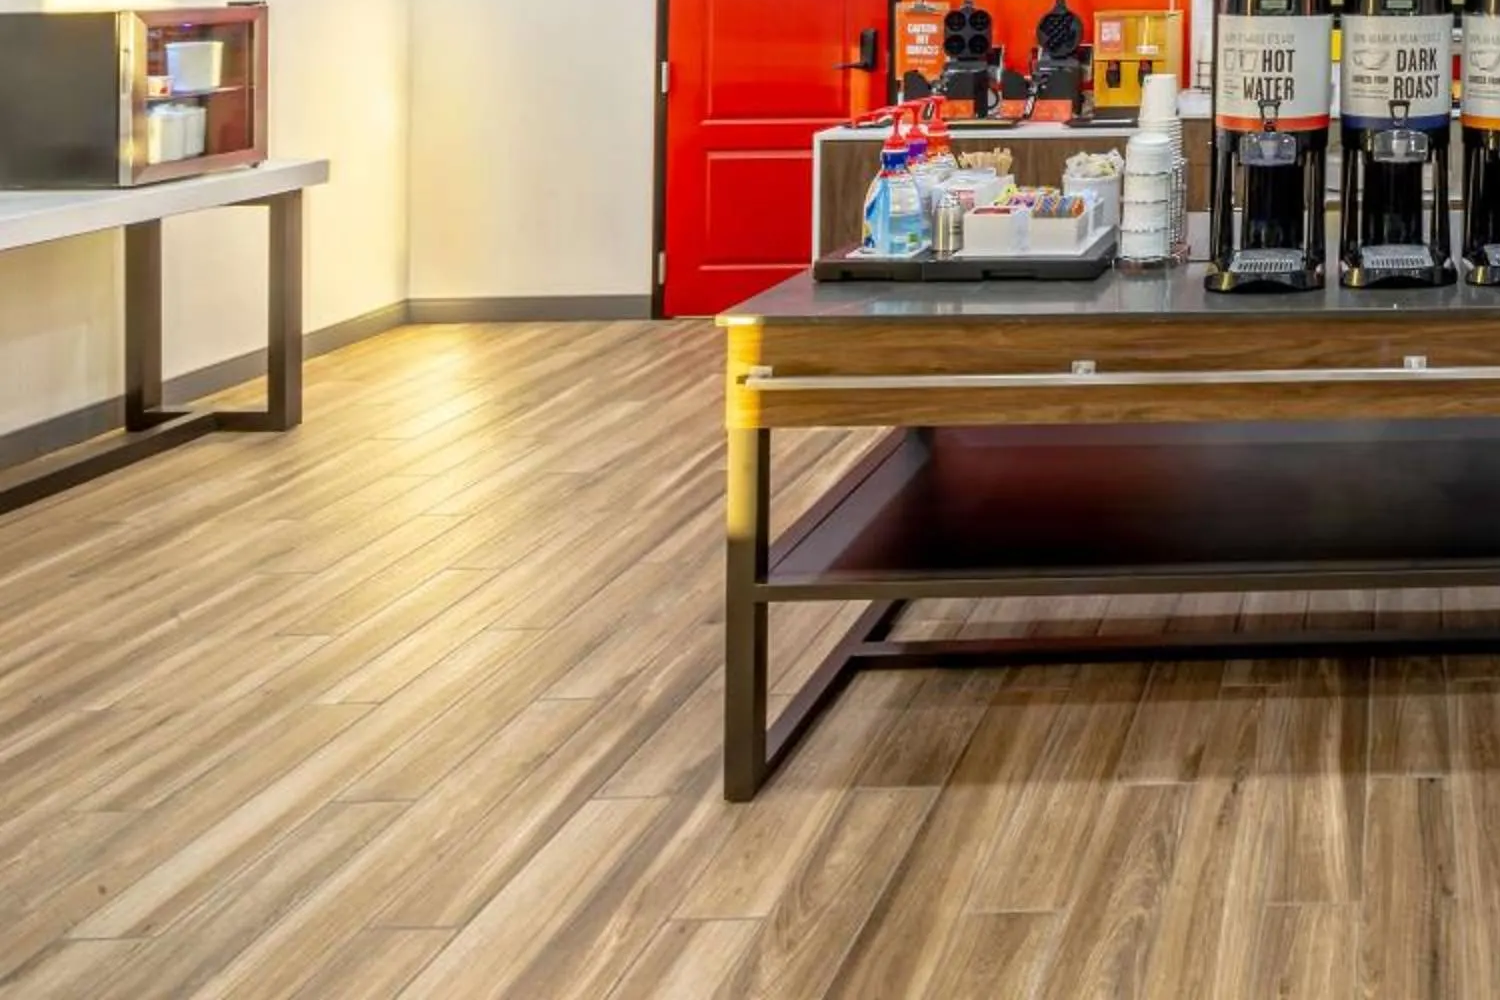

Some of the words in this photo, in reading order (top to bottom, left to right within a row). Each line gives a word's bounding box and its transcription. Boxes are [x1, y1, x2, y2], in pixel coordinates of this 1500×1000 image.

[1262, 49, 1297, 73] HOT
[1397, 48, 1437, 73] DARK
[1243, 76, 1295, 101] WATER
[1393, 74, 1441, 99] ROAST
